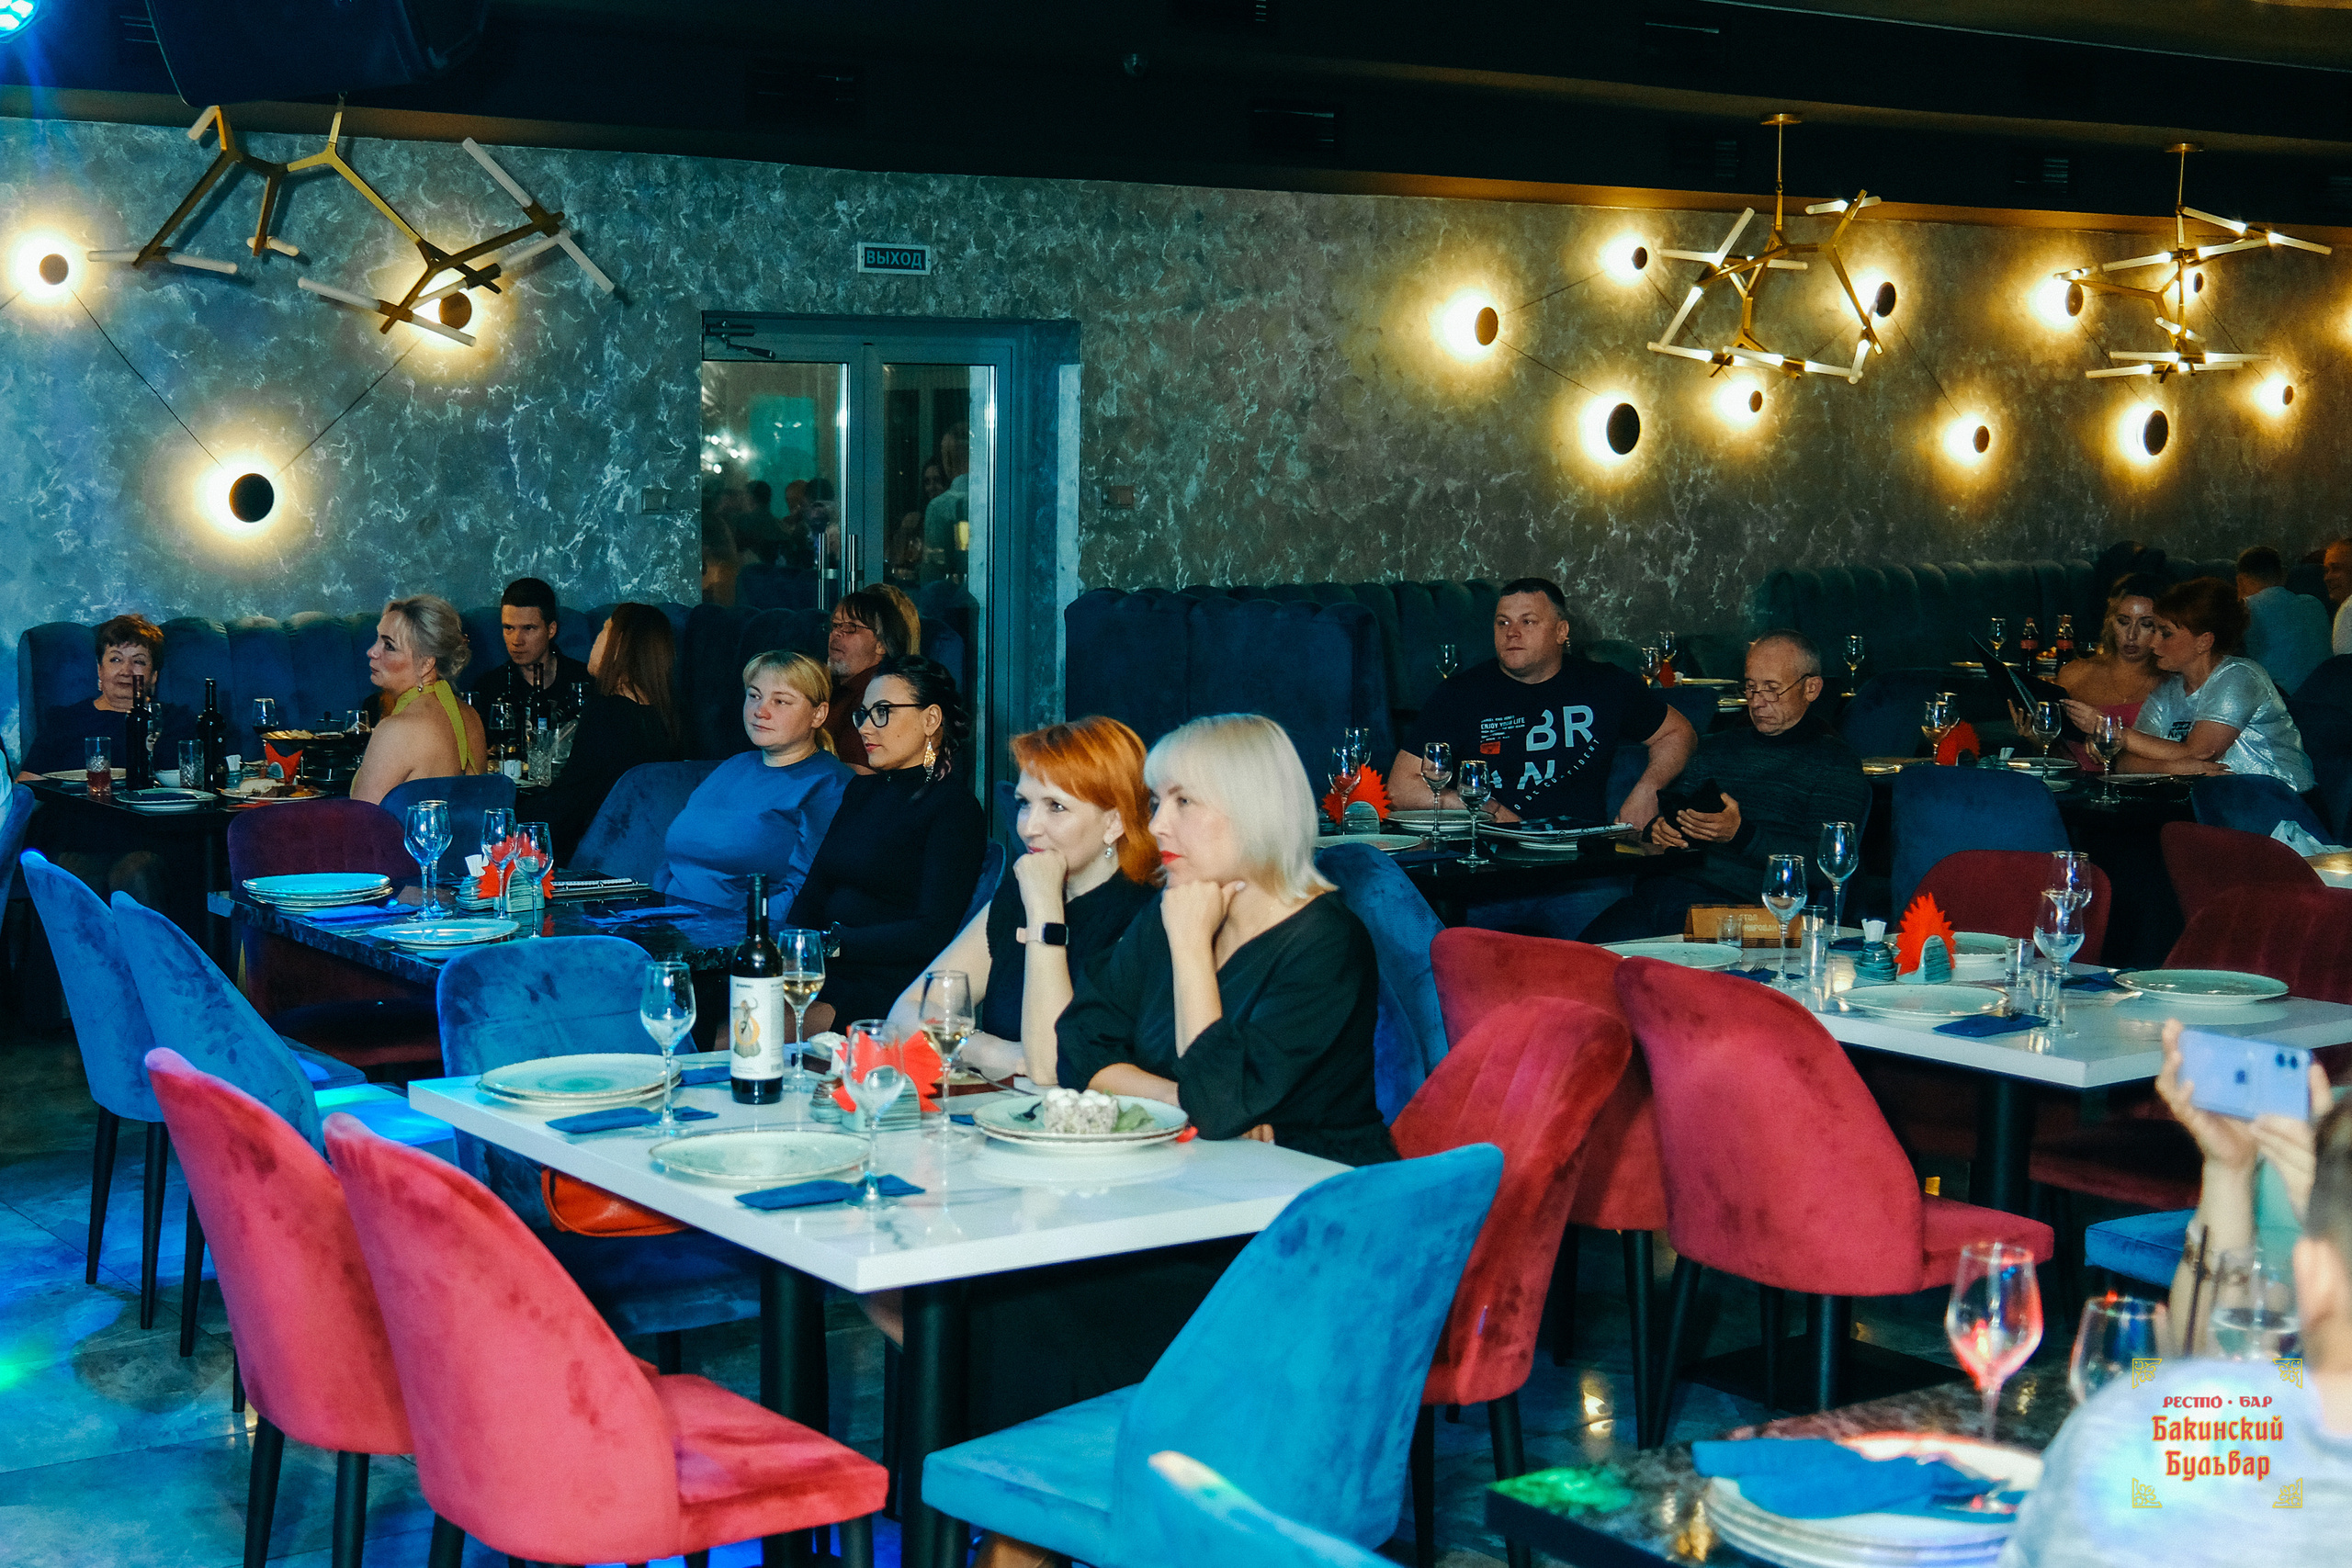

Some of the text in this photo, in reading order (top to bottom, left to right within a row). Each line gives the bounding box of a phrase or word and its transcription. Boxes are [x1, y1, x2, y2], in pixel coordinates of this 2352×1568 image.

[866, 250, 922, 269] ВЫХОД
[1513, 716, 1525, 725] LIFE
[1544, 739, 1600, 787] COFIDENT
